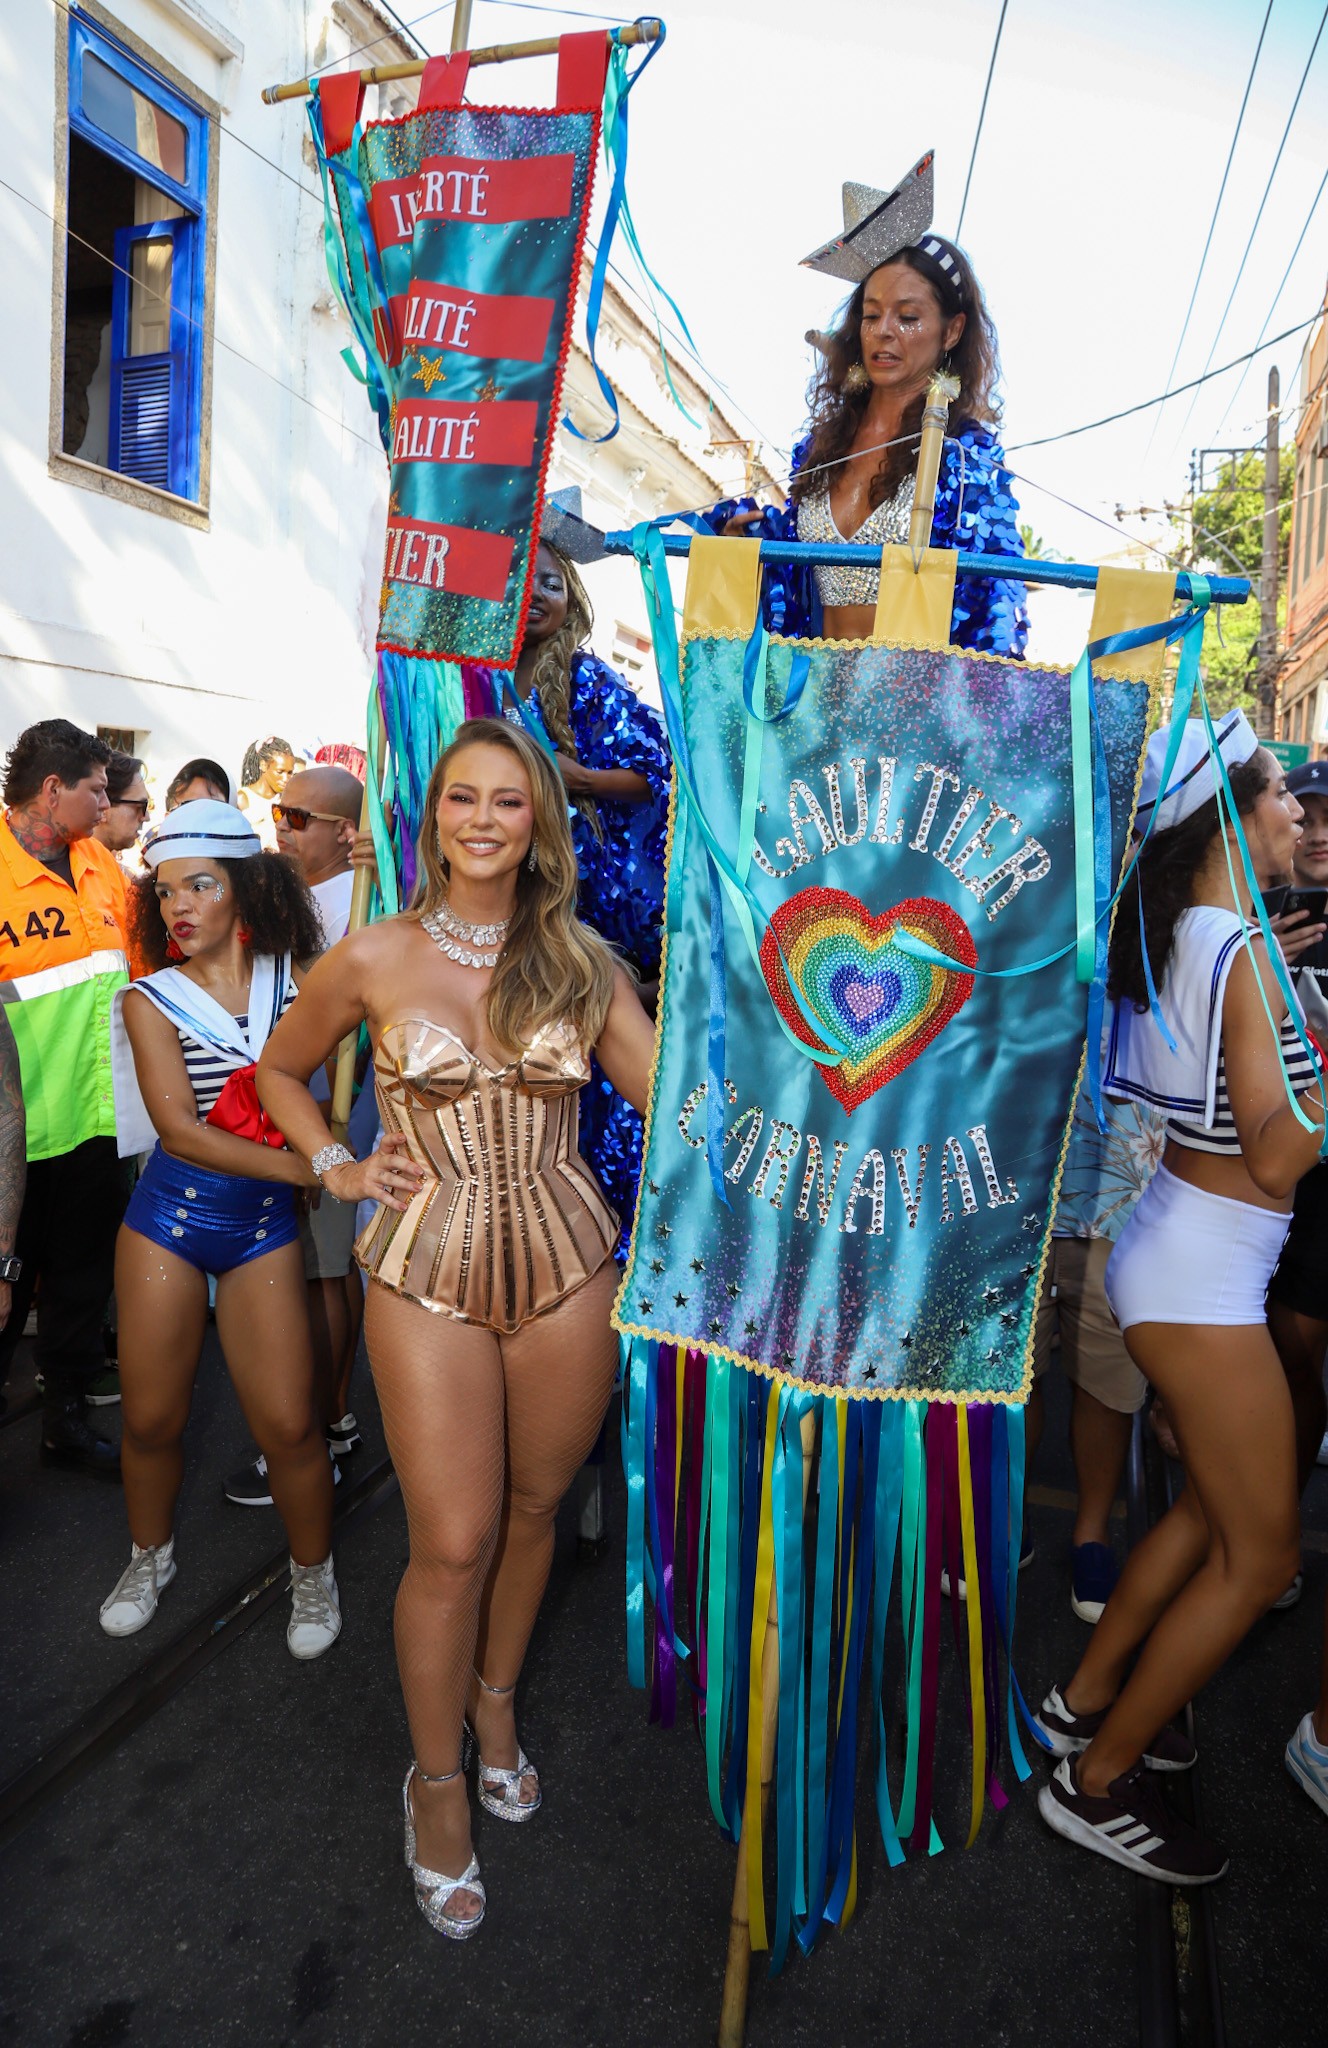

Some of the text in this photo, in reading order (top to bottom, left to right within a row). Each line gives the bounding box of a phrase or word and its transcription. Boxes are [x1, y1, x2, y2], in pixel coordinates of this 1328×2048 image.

[404, 296, 477, 348] LITÉ
[393, 411, 480, 459] ALITÉ
[752, 755, 1051, 921] GAULTIER
[678, 1078, 1020, 1235] CARNAVAL
